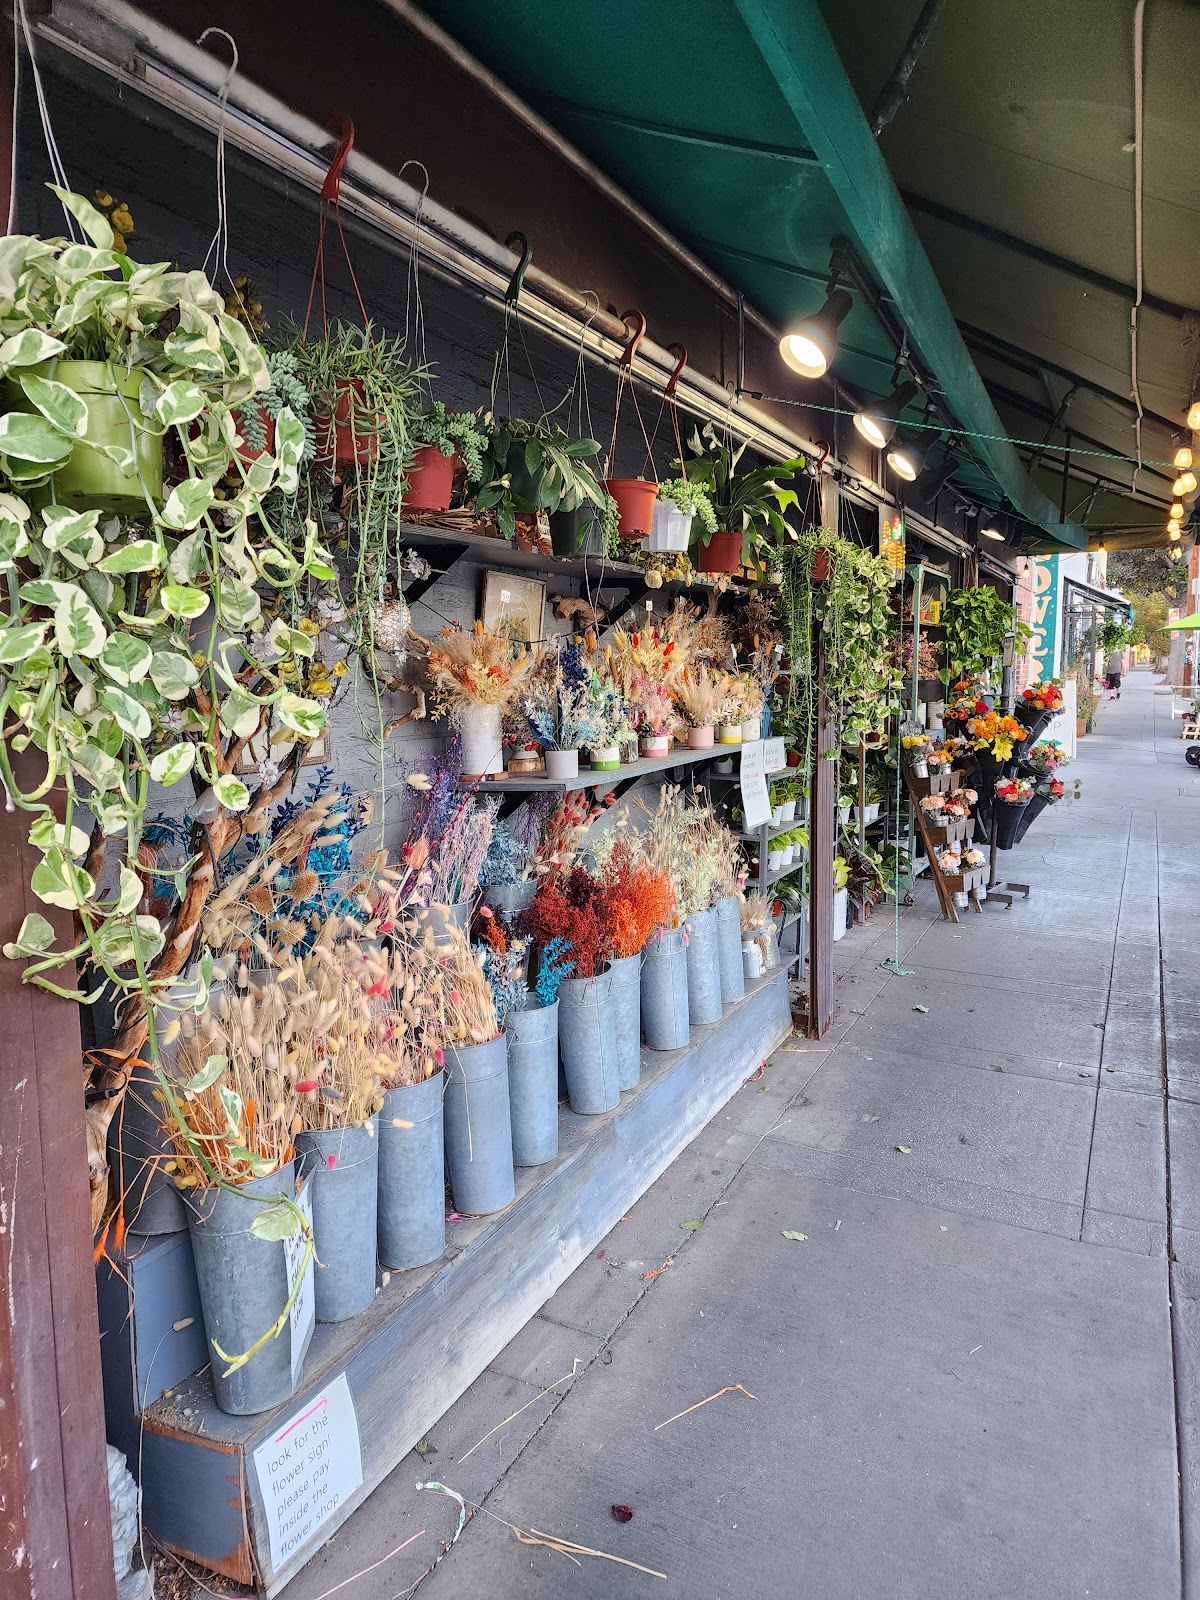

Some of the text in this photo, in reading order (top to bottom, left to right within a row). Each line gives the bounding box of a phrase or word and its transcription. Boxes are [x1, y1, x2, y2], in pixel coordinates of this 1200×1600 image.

[267, 1415, 328, 1476] look for the
[271, 1433, 332, 1496] flower sign!
[277, 1459, 331, 1521] please pay
[278, 1482, 328, 1538] inside the
[280, 1492, 339, 1558] flower shop
